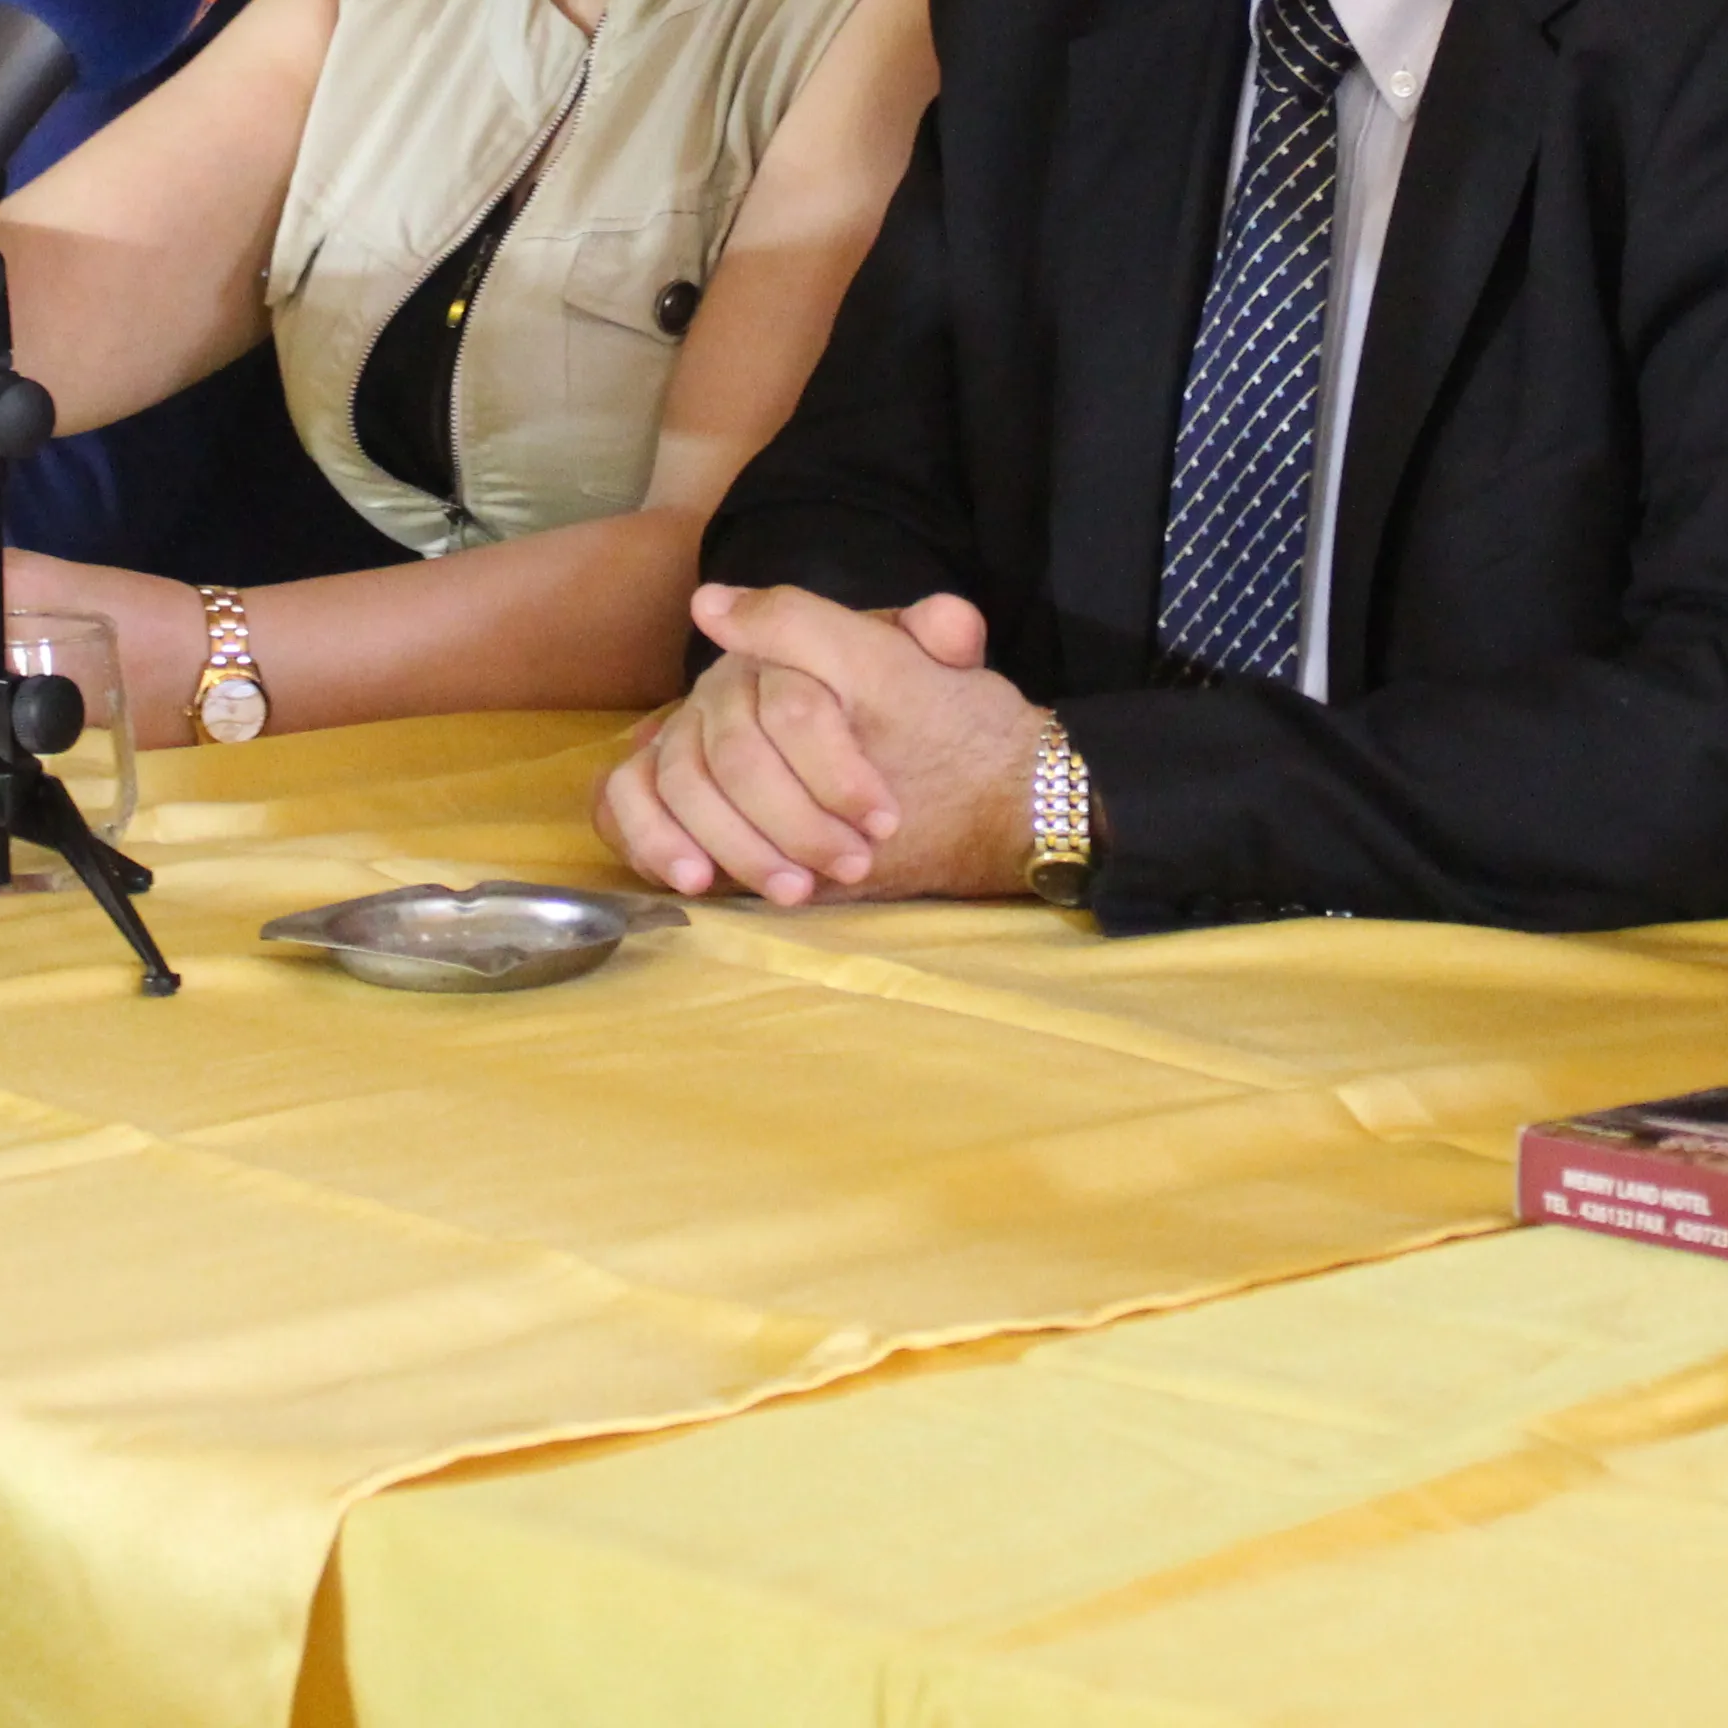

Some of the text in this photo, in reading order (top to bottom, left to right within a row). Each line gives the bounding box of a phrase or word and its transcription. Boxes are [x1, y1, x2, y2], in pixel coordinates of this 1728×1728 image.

[1561, 1169, 1712, 1217] MERRY LAND HOTEL
